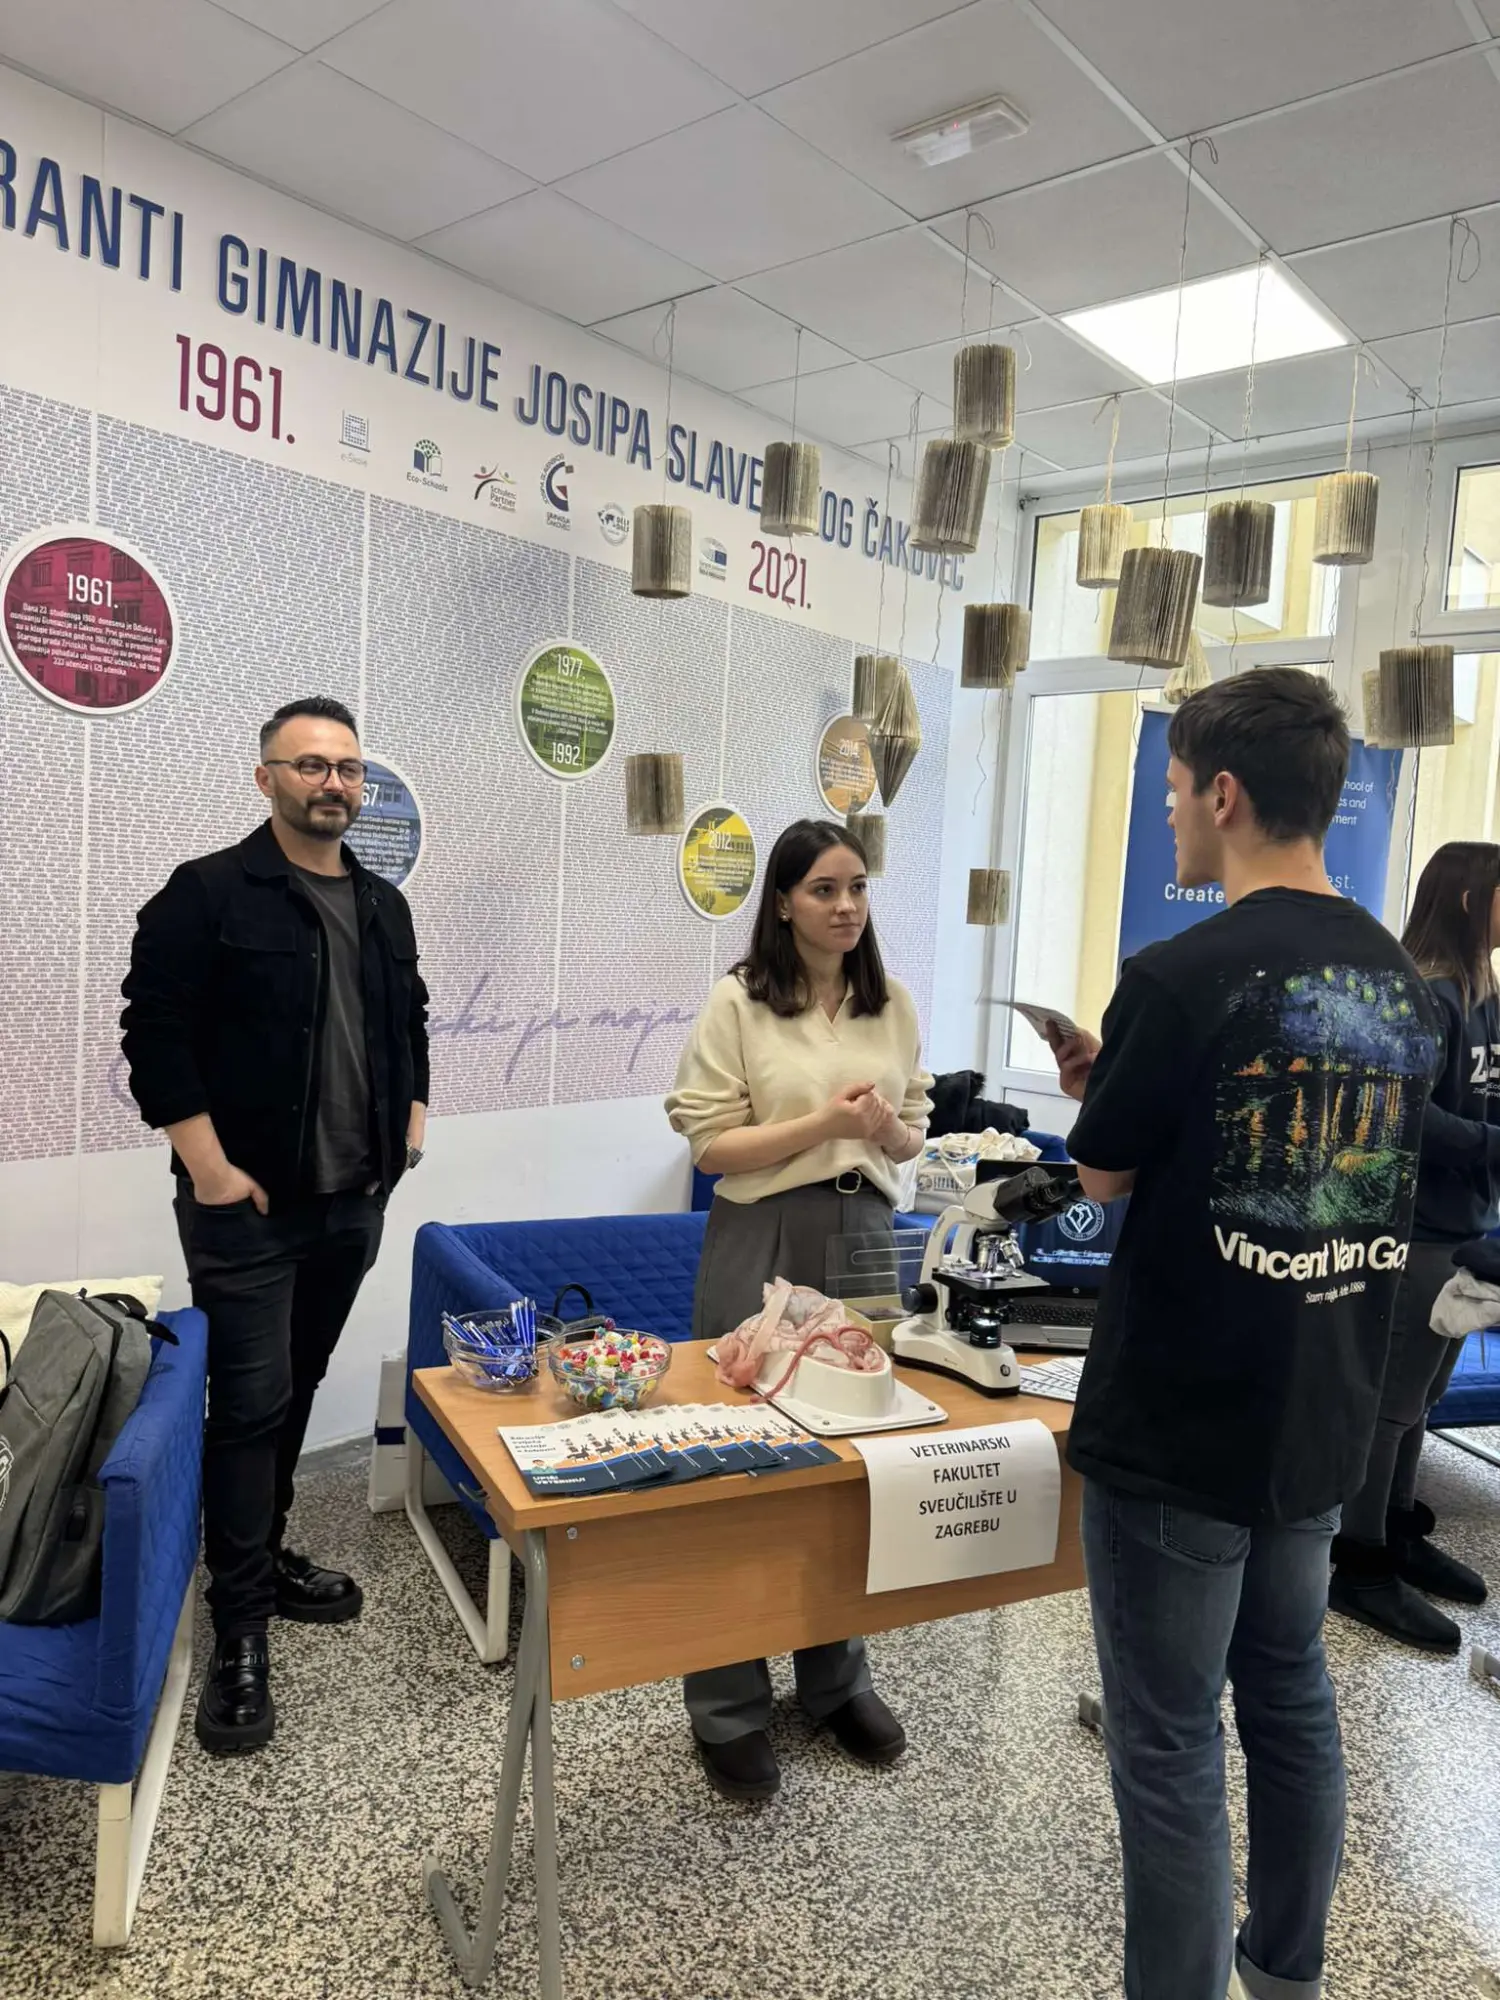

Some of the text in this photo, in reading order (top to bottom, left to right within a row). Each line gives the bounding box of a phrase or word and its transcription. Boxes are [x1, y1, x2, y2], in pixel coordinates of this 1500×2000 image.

[176, 333, 296, 444] 1961.
[217, 234, 502, 412] GIMNAZIJE
[515, 364, 652, 471] JOSIPA
[666, 424, 854, 549] SLAVEOG
[406, 471, 448, 492] Eco-Schools
[490, 493, 516, 508] Partner
[748, 541, 811, 609] 2021.
[66, 572, 119, 609] 1961.
[556, 653, 586, 680] 1977.
[551, 741, 583, 766] 1992.
[361, 783, 383, 807] 67.
[1343, 780, 1375, 793] hool of
[1348, 798, 1367, 810] and
[1164, 883, 1225, 903] Create
[1214, 1224, 1329, 1281] Vincent
[1332, 1236, 1365, 1274] Van
[910, 1436, 1011, 1458] VETERINARSKI
[933, 1462, 1001, 1483] FAKULTET
[919, 1490, 1018, 1516] SVEUČILIŠTE U
[935, 1518, 1000, 1539] ZAGREBU
